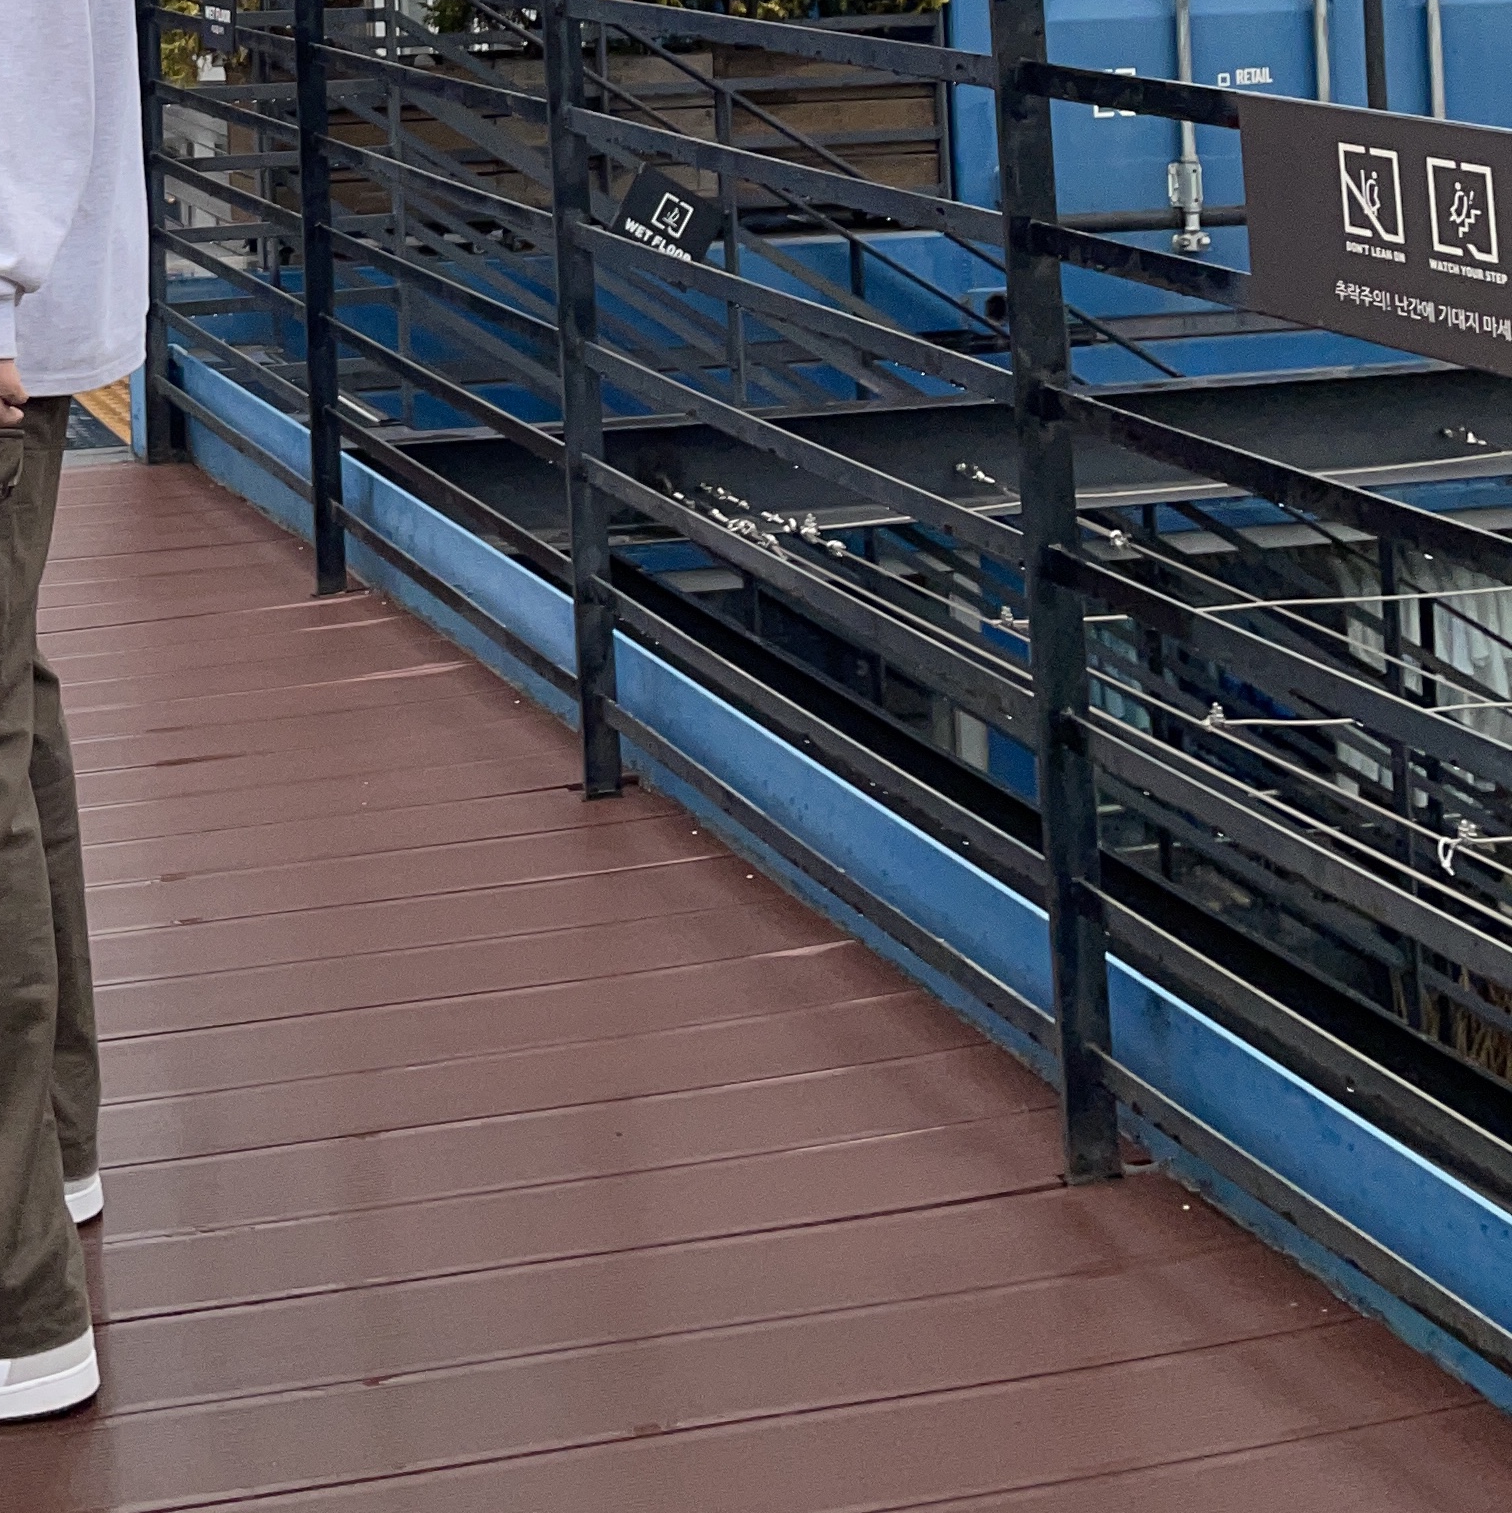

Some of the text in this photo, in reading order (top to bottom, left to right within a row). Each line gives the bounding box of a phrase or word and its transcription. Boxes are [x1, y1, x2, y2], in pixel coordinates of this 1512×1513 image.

[1236, 67, 1273, 85] RETAIL
[625, 217, 654, 241] WET
[1371, 246, 1393, 260] LEAN
[1429, 258, 1509, 285] WATCH YOUR STEP
[1335, 280, 1392, 311] 추락주의!
[1395, 294, 1436, 323] 난간에
[1438, 305, 1480, 333] 기대지
